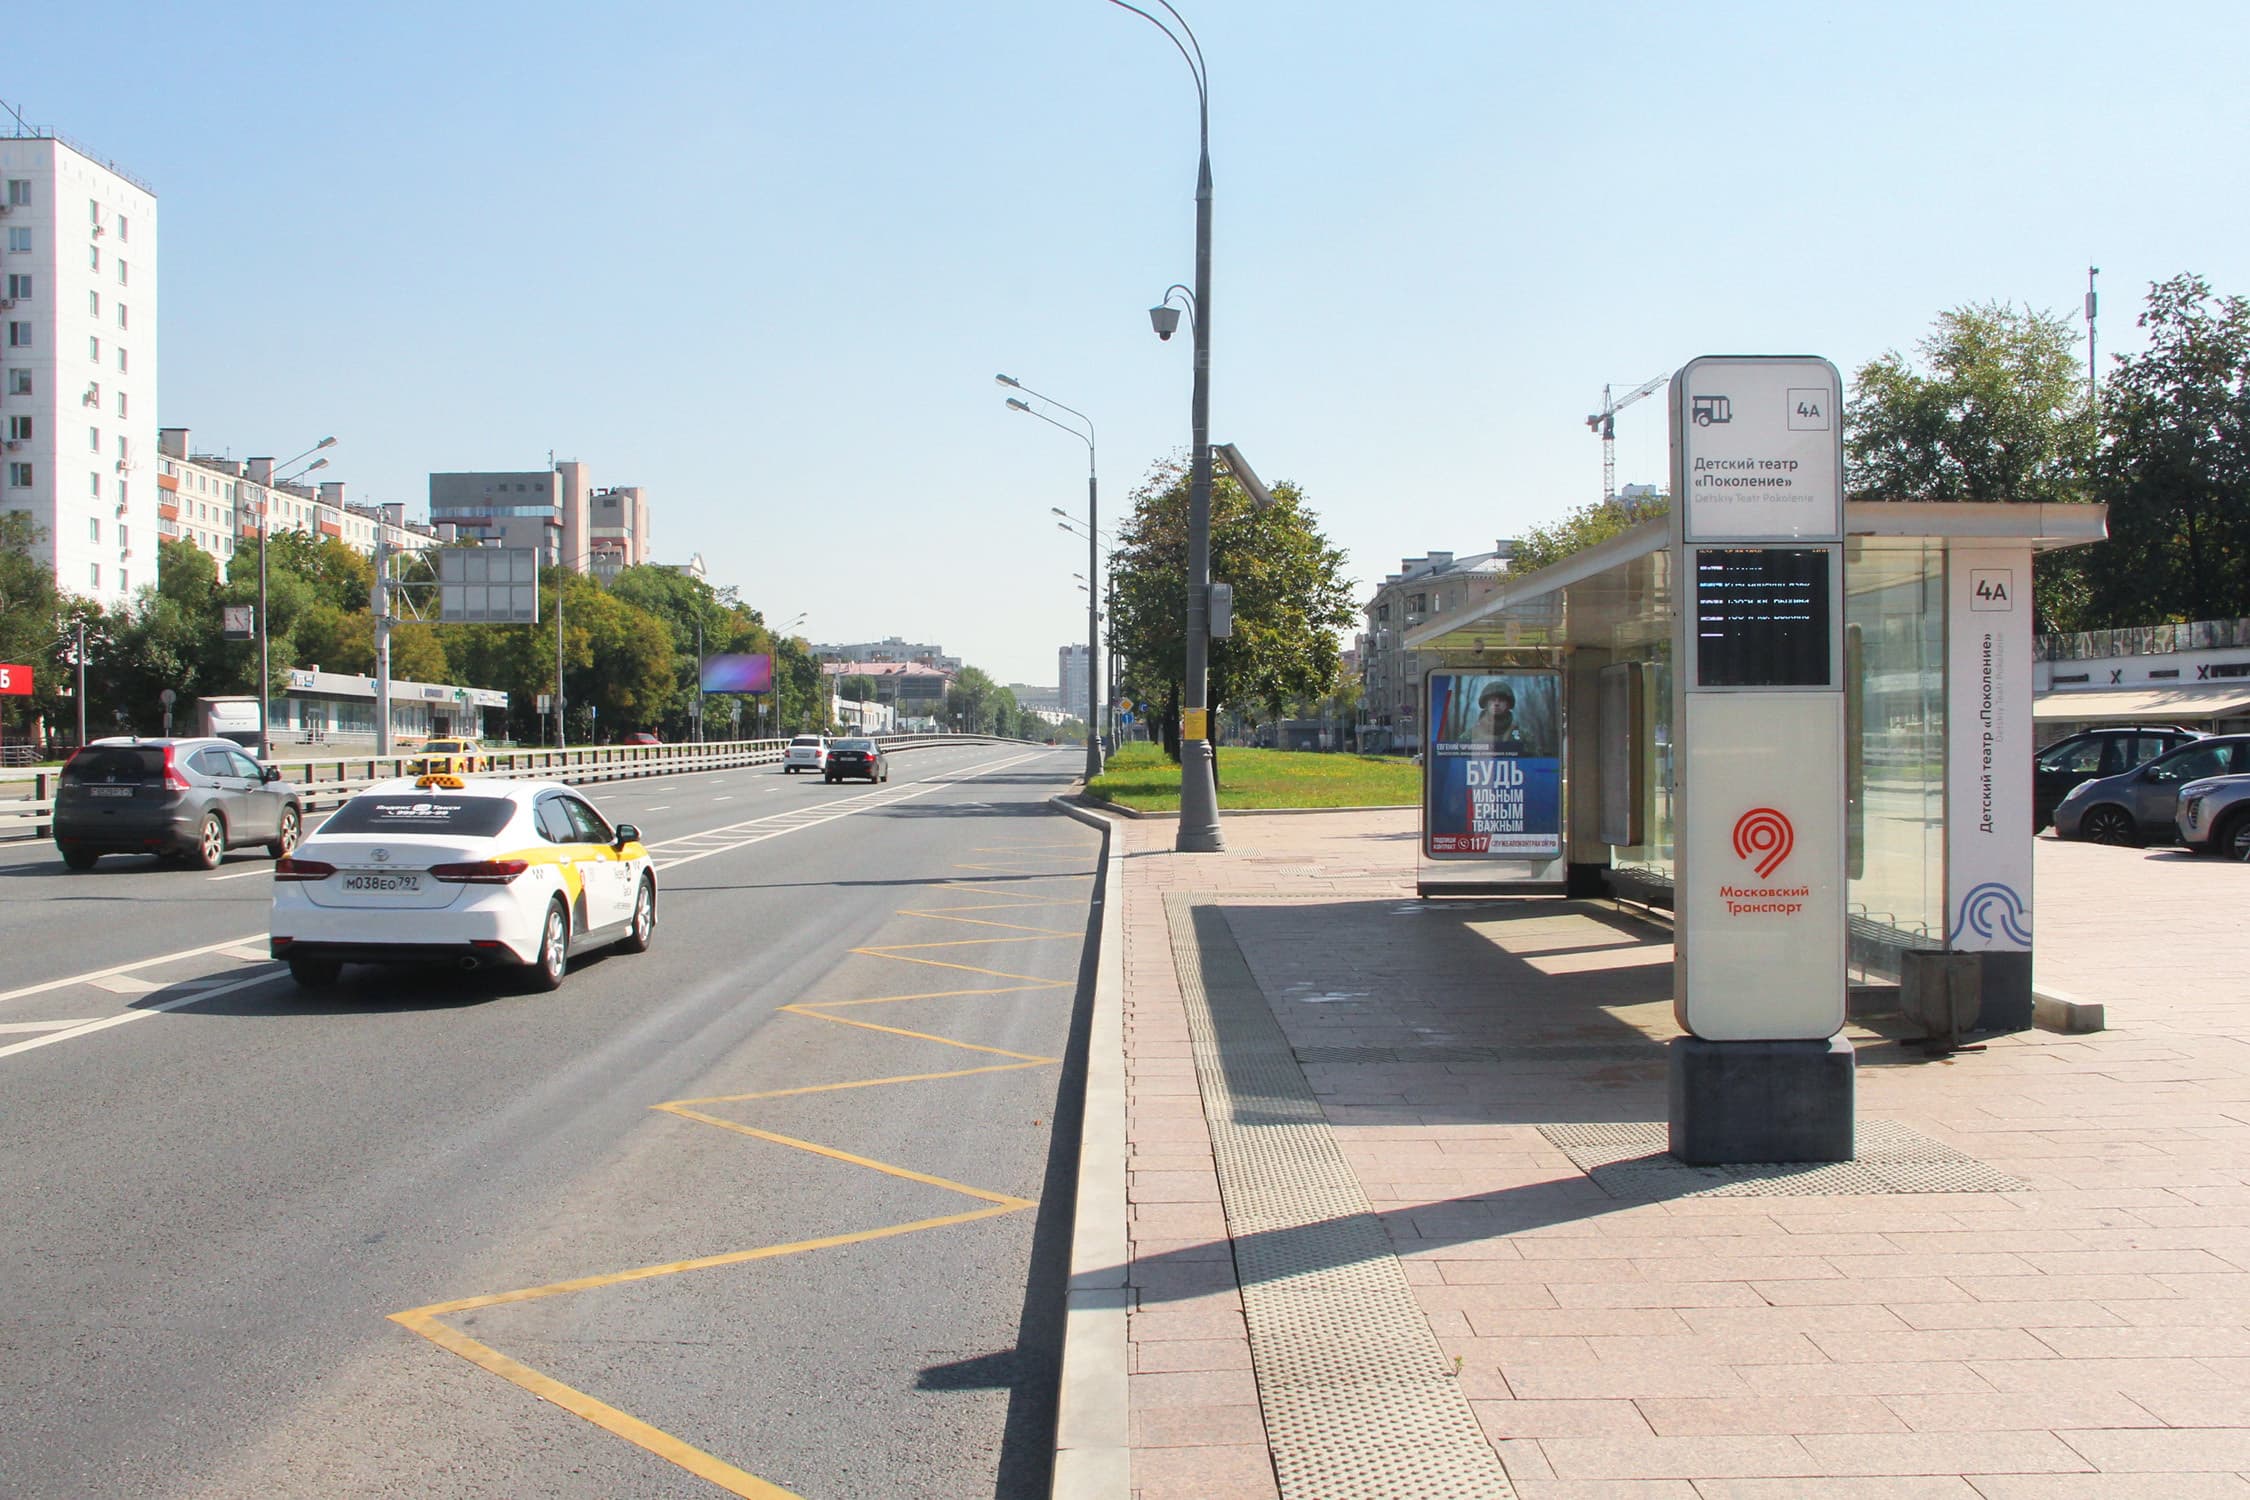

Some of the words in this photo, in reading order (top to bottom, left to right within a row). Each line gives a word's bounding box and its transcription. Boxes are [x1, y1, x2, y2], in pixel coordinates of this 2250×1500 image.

[1695, 457, 1754, 471] Детский
[1759, 460, 1798, 473] театр
[1695, 475, 1792, 487] «Поколение»
[1980, 633, 1993, 728] «Поколение»
[1982, 731, 1994, 770] театр
[1466, 761, 1524, 788] БУДЬ
[1980, 775, 1994, 834] Детский
[1470, 838, 1488, 850] 117
[1720, 886, 1809, 897] Московский
[1726, 901, 1802, 916] Транспорт
